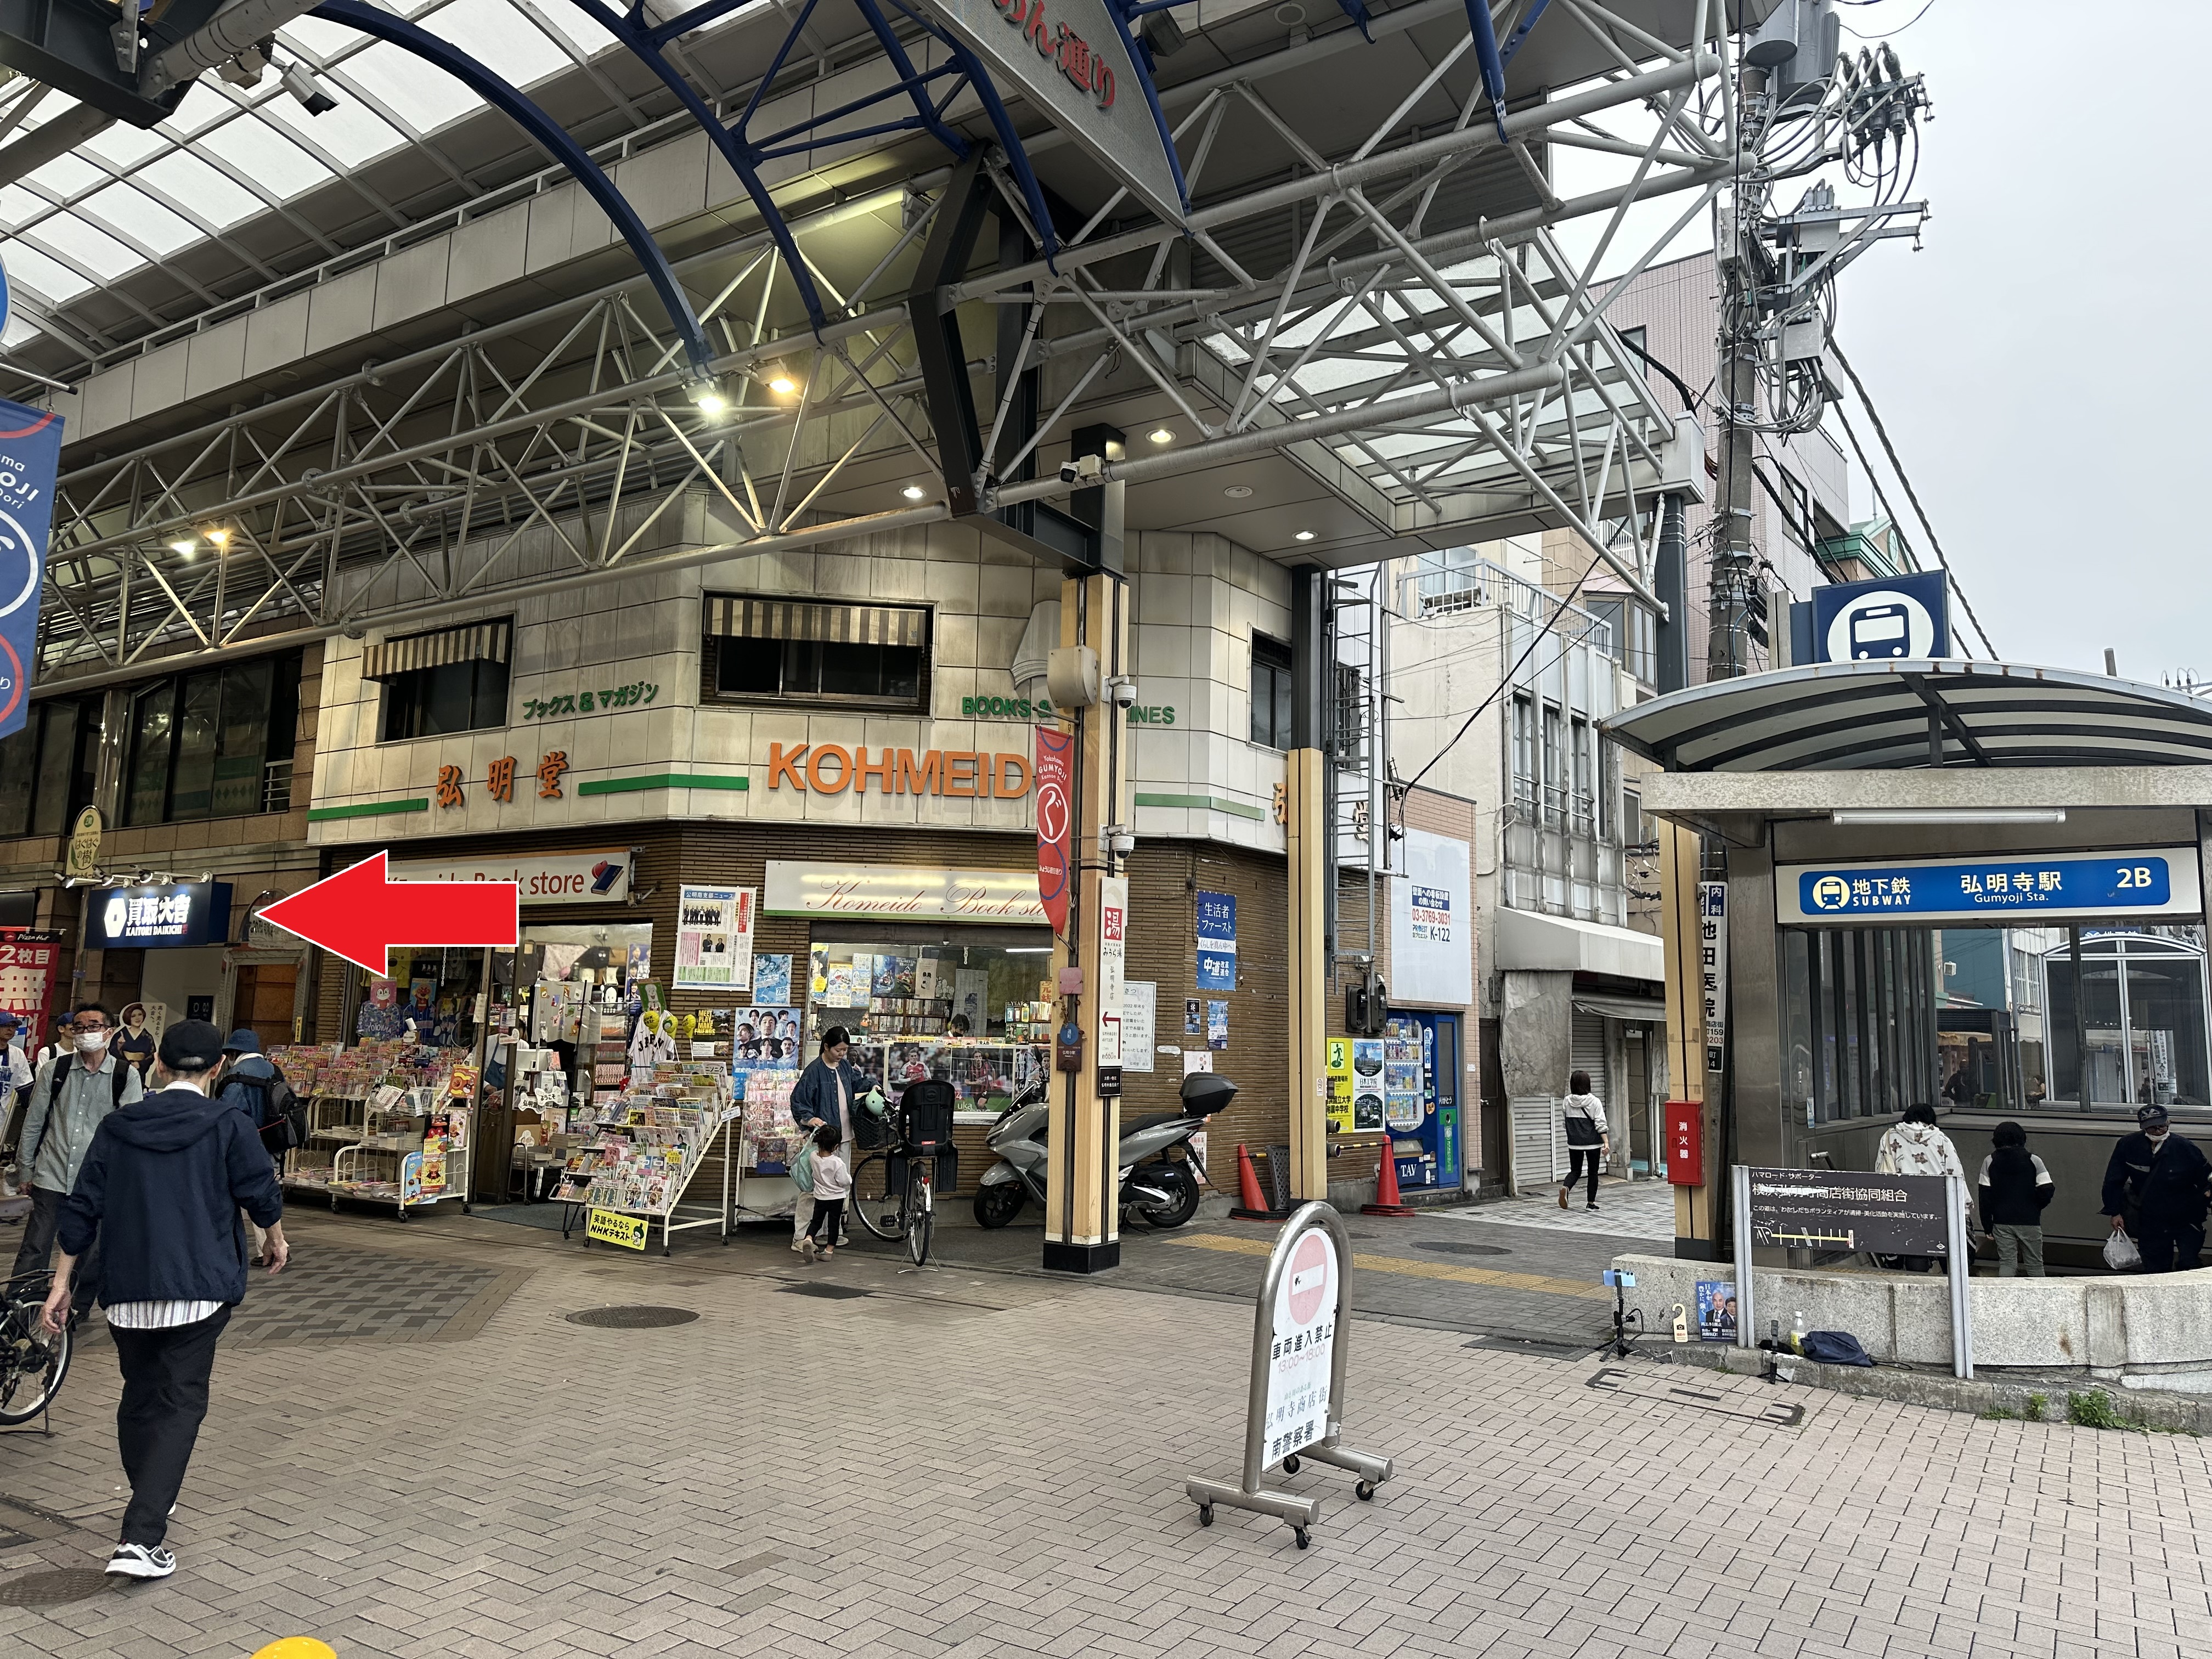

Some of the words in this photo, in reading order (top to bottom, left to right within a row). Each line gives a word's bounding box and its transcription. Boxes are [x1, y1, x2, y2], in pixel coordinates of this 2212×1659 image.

[962, 696, 1031, 718] BOOKS
[1043, 755, 1064, 767] Yokohama
[769, 742, 1032, 799] KOHMEID
[1039, 764, 1067, 781] GUMYOJI
[437, 751, 569, 809] 弘明堂
[75, 837, 99, 850] はぐはぐ
[530, 873, 584, 895] store
[1852, 877, 1911, 896] 地下鉄
[1961, 872, 2063, 894] 弘明寺駅
[2116, 867, 2152, 889] 2B
[941, 881, 1016, 917] Book
[1418, 897, 1443, 909] の問い合わせ
[1711, 887, 1722, 916] 内科
[1853, 895, 1911, 906] SUBWAY
[1974, 893, 2022, 904] Gumyoji
[2026, 891, 2050, 902] Sta.
[127, 894, 191, 926] 買取大吉
[1204, 902, 1229, 919] 生活者
[1412, 908, 1451, 926] 03-3769-3031
[126, 926, 153, 937] KAITORI
[153, 924, 183, 935] DAIKICHI
[1105, 910, 1121, 939] 湯
[1201, 919, 1232, 934] ファースト
[1430, 926, 1451, 942] K-122
[1103, 947, 1122, 958] みうら湯
[1204, 956, 1221, 977] 中道
[1359, 1077, 1378, 1086] 日本工学院
[1678, 1121, 1689, 1160] 消火器
[593, 1214, 630, 1231] 英語やるなら
[590, 1224, 630, 1242] NHKテキスト
[1272, 1322, 1333, 1361] 車両進入禁止
[1265, 1385, 1328, 1431] 弘明寺商店街
[1271, 1420, 1315, 1461] 南警察署
